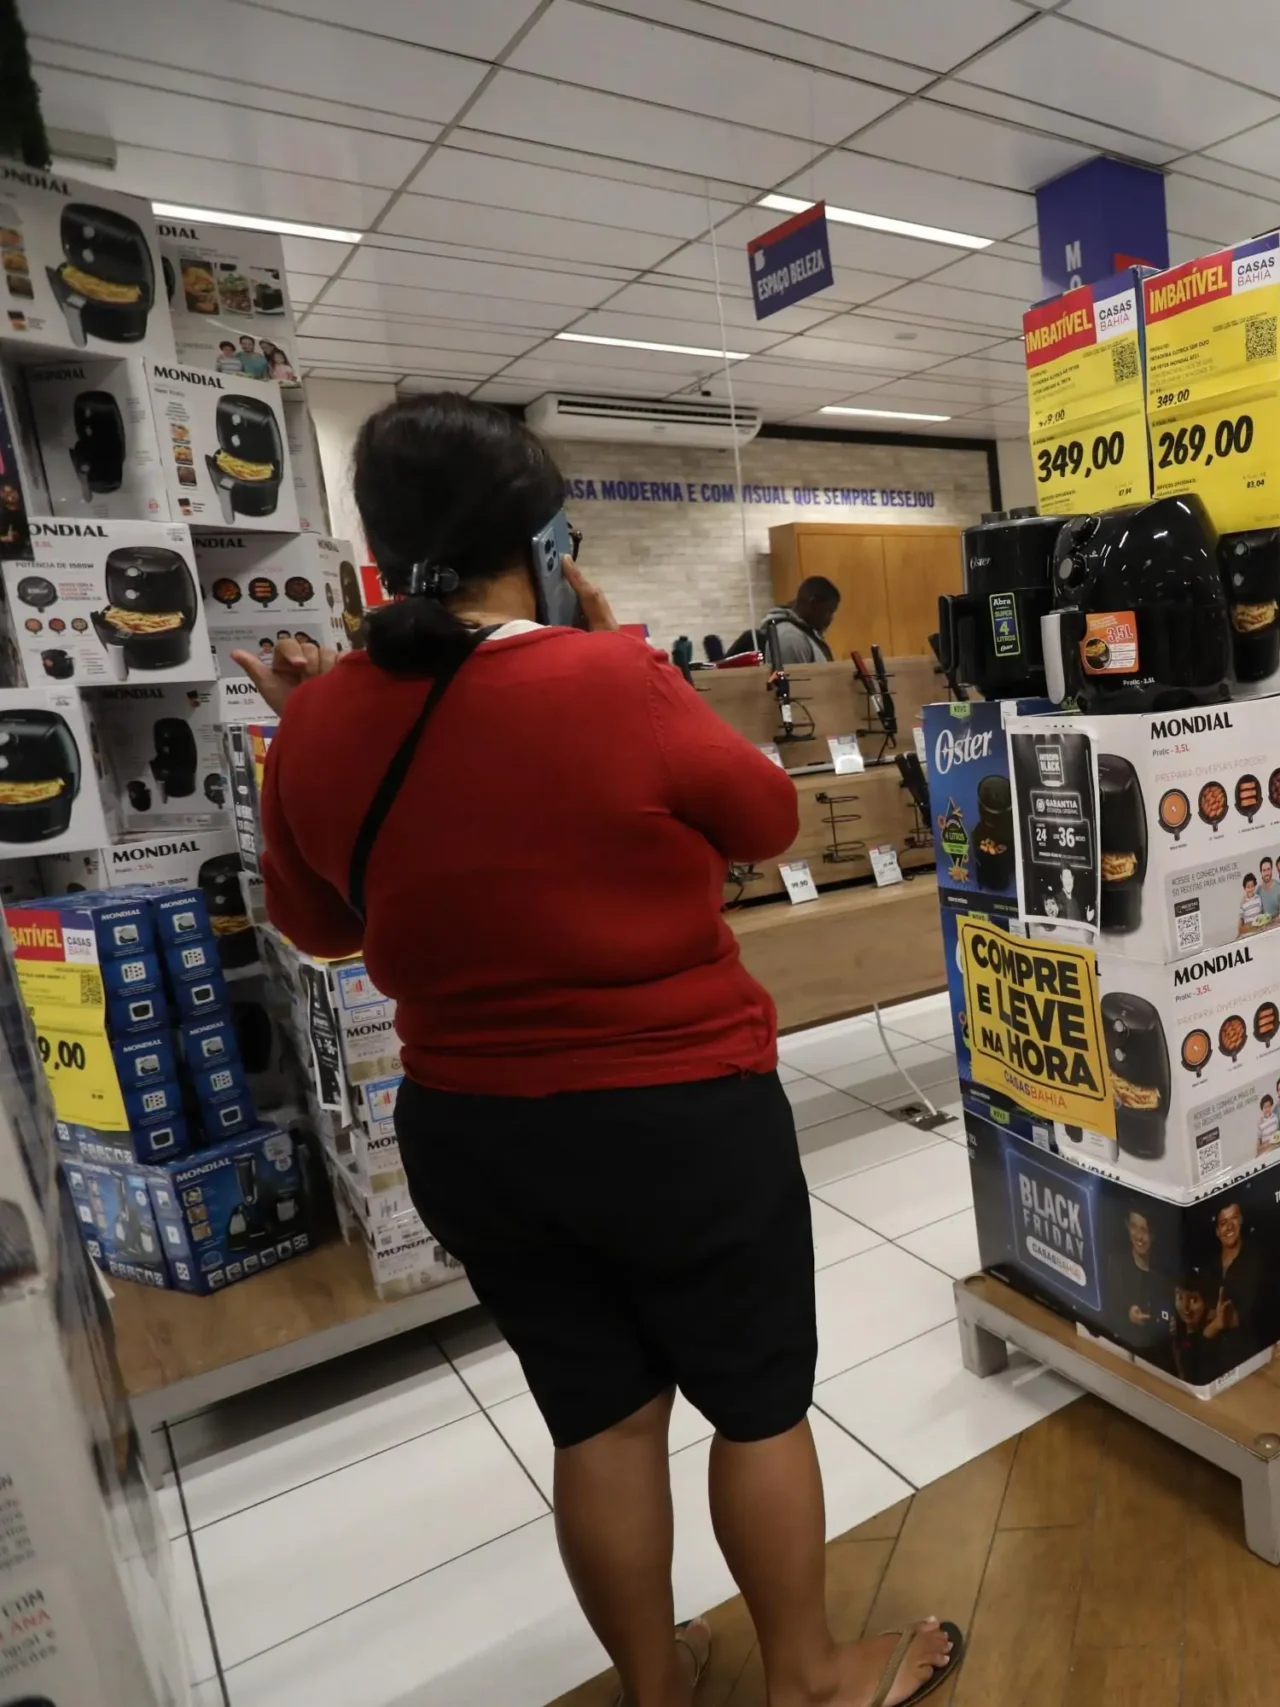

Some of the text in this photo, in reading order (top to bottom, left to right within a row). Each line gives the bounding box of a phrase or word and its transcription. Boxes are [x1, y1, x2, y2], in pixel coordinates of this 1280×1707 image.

[757, 249, 825, 301] ESPAÇO BELEZA
[1237, 256, 1275, 276] CASAS
[1150, 264, 1228, 314] IMBATÍVEL
[1237, 270, 1272, 287] BAHIA
[1099, 299, 1132, 320] CASAS
[1026, 309, 1093, 353] IMBATÍVEL
[1099, 313, 1130, 332] BAHIA
[154, 365, 225, 389] MONDIAL
[1158, 415, 1254, 470] 269,00
[1037, 431, 1125, 483] 349,00
[601, 479, 684, 502] MODERNA
[687, 483, 697, 503] E
[701, 483, 735, 504] COM
[792, 487, 820, 506] QUE
[823, 487, 877, 507] SEMPRE
[881, 489, 935, 508] DESEJOU
[993, 597, 1011, 607] Abra
[999, 620, 1010, 636] 4
[1150, 711, 1233, 741] MONDIAL
[935, 729, 992, 775] Oster
[1040, 761, 1060, 772] BLACK
[1045, 799, 1078, 809] GARANTIA
[1036, 828, 1047, 842] 24
[1058, 826, 1075, 848] 36
[113, 841, 200, 863] MONDIAL
[160, 897, 197, 909] MONDIAL
[101, 908, 142, 921] MONDIAL
[66, 935, 92, 948] CASAS
[971, 934, 1081, 1000] COMPRE
[1173, 946, 1253, 987] MONDIAL
[976, 977, 1089, 1051] E LEVE
[189, 1020, 224, 1036] MONDIAL
[346, 1020, 394, 1038] MOND
[123, 1037, 162, 1053] MONDIAL
[982, 1026, 1099, 1093] NA HORA
[176, 1156, 232, 1183] MONDIAL
[1018, 1172, 1084, 1240] BLACK
[1022, 1207, 1084, 1261] FRIDAY
